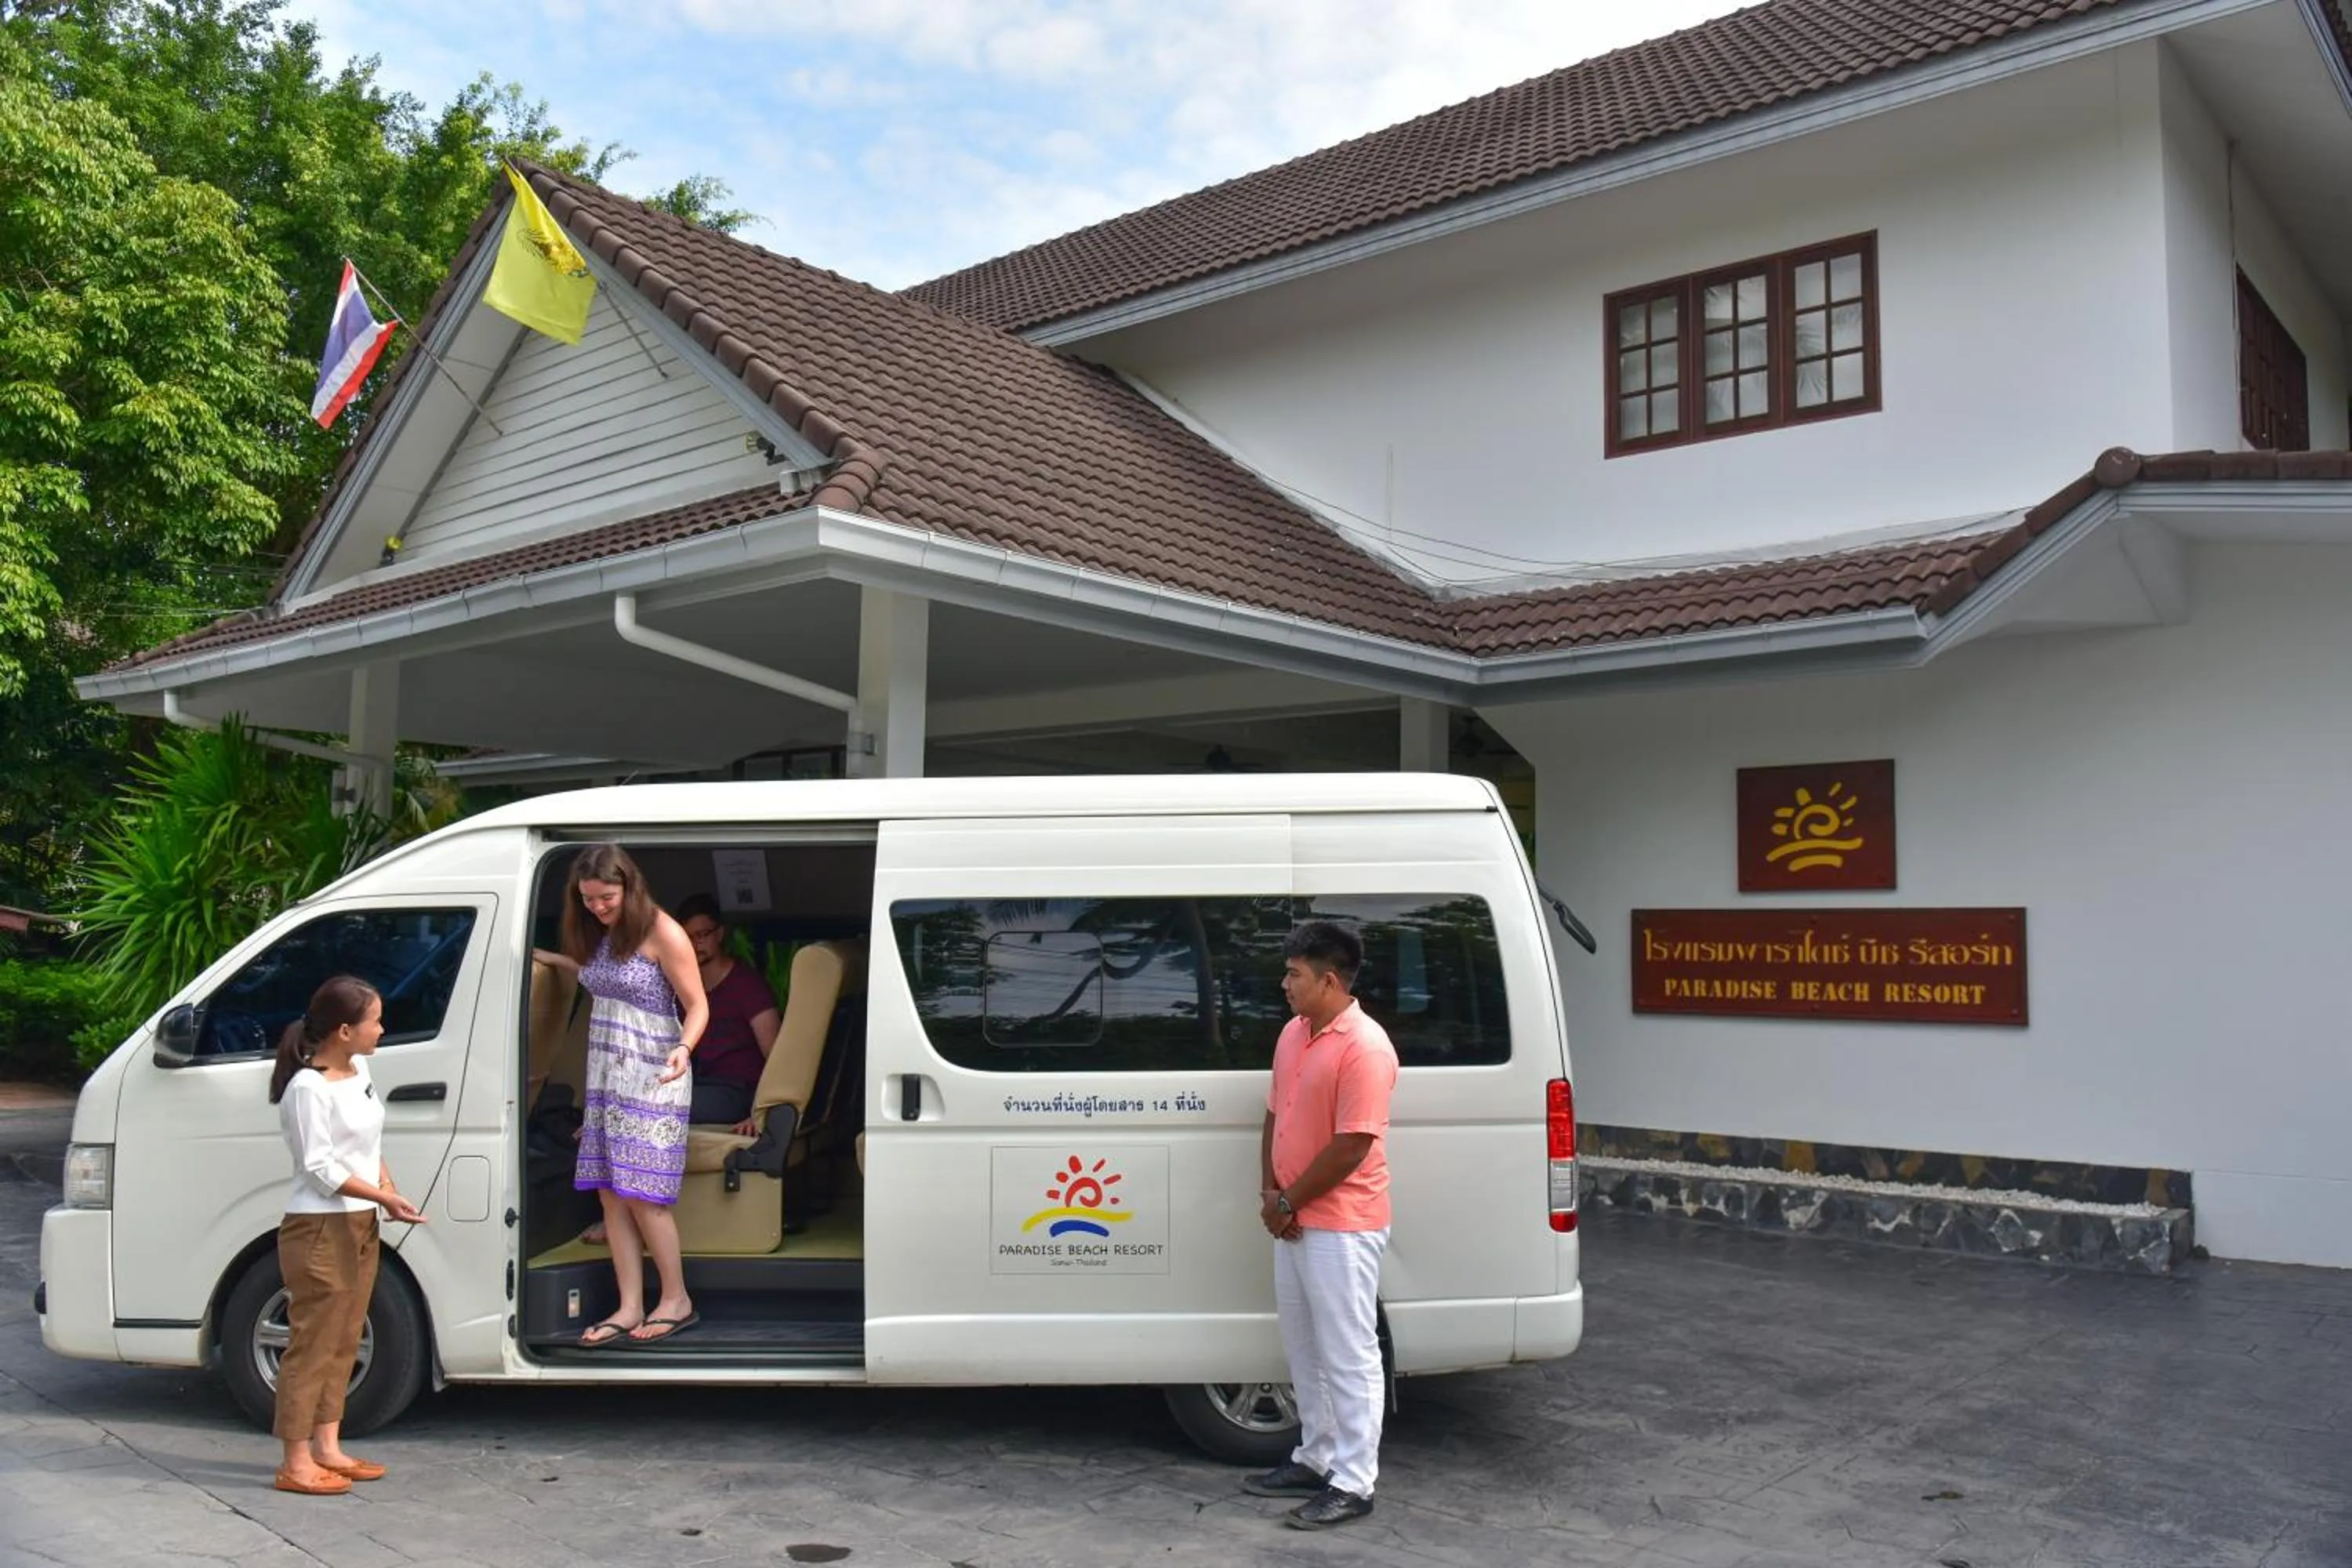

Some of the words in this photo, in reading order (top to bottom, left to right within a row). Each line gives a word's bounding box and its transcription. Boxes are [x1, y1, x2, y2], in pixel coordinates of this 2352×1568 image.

[1664, 978, 1777, 1000] PARADISE
[1791, 980, 1871, 1002] BEACH
[1883, 982, 1987, 1005] RESORT
[1152, 1100, 1168, 1111] 14
[1174, 1091, 1206, 1111] ที่นั่ง
[999, 1244, 1062, 1255] PARADISE
[1068, 1244, 1108, 1255] BEACH
[1114, 1244, 1164, 1255] RESORT
